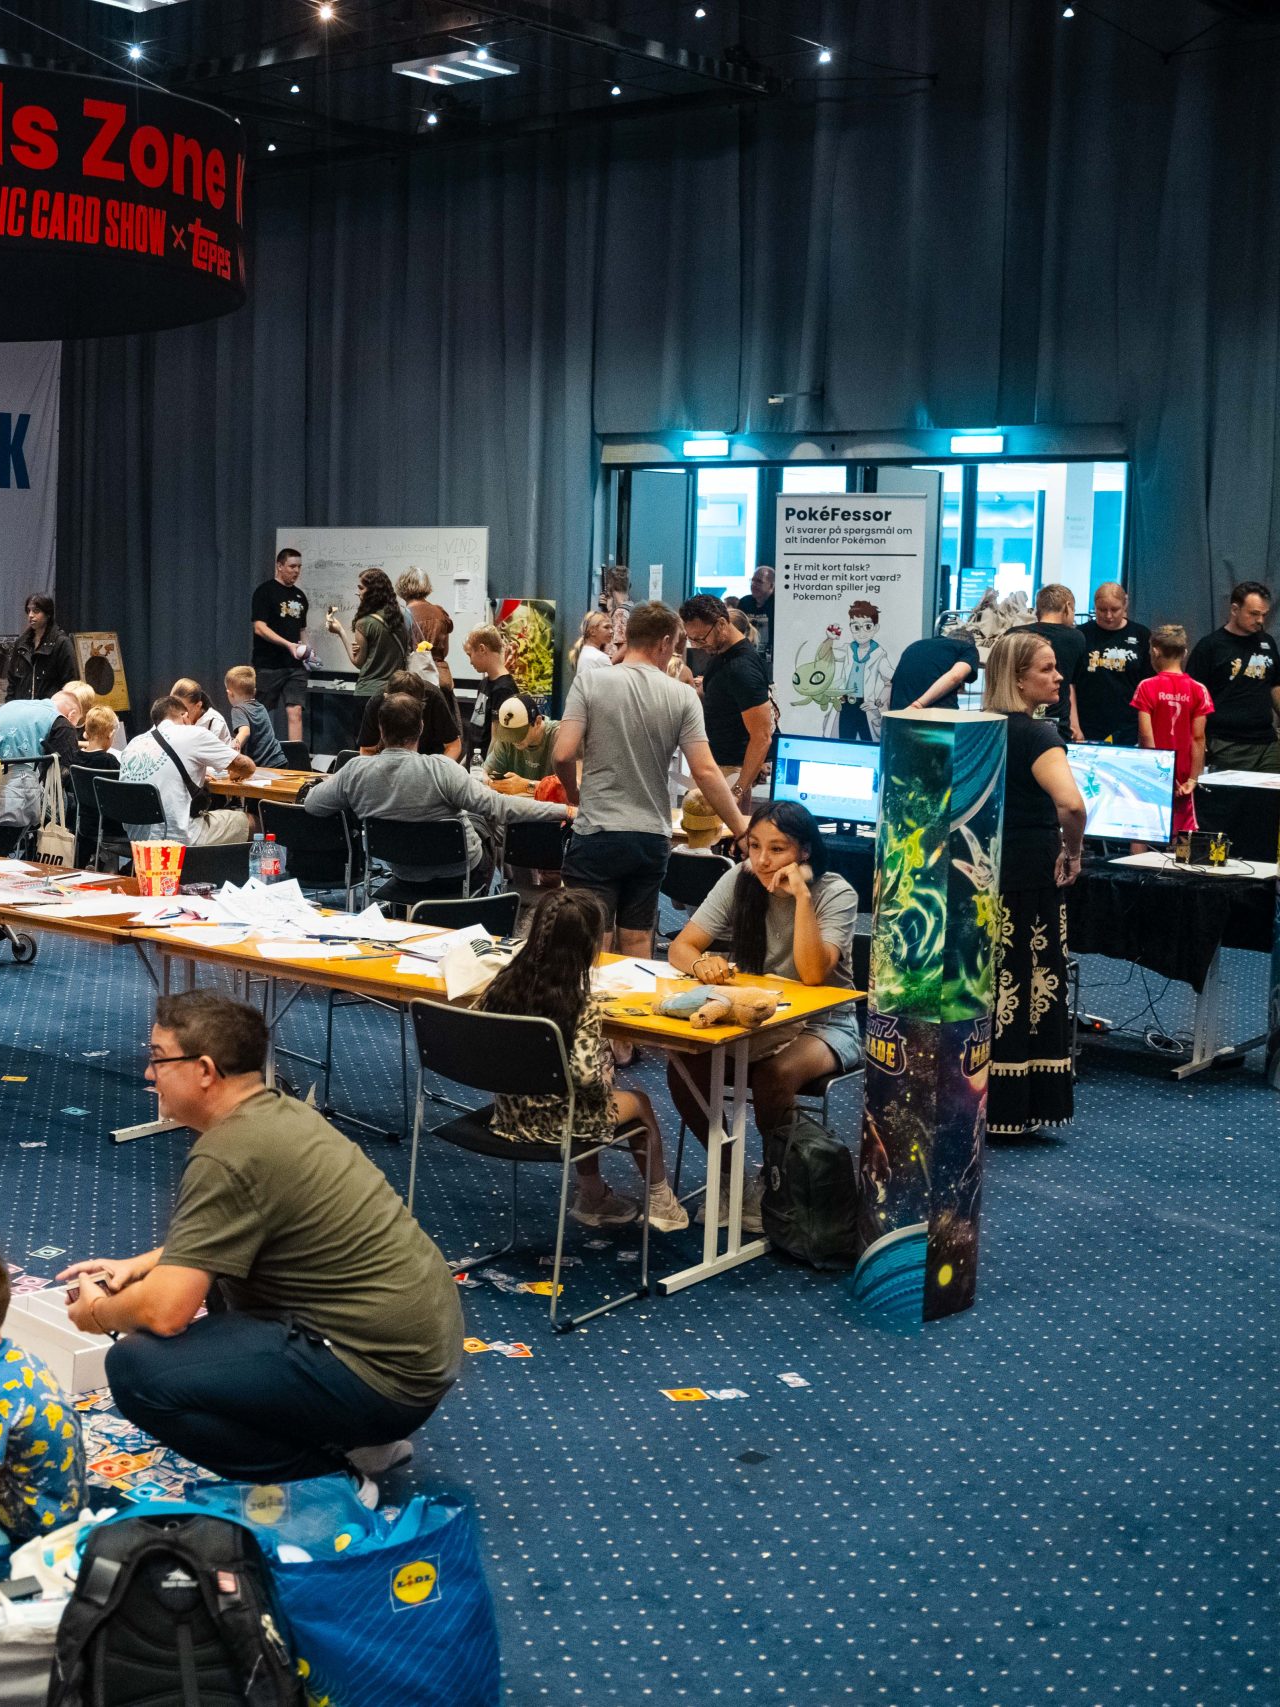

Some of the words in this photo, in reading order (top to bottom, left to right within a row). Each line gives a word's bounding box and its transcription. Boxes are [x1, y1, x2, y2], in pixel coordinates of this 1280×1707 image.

[83, 98, 226, 209] Zone
[29, 189, 101, 244] CARD
[105, 199, 167, 256] SHOW
[785, 506, 892, 522] PokéFessor
[785, 526, 795, 534] Vi
[796, 527, 827, 535] svarer
[829, 526, 842, 537] på
[843, 526, 895, 537] spørgsmål
[785, 536, 798, 544] alt
[800, 535, 840, 545] indenfor
[841, 536, 886, 545] Pokémon
[806, 563, 820, 571] mit
[822, 563, 841, 572] kort
[843, 563, 871, 572] falsk?
[793, 573, 818, 581] Hvad
[831, 573, 846, 582] mit
[849, 573, 868, 582] kort
[870, 573, 902, 582] værd?
[793, 583, 834, 592] Hvordan
[835, 583, 864, 593] spiller
[865, 583, 881, 594] jeg
[793, 592, 842, 601] Pokemon?
[1168, 701, 1182, 736] 7
